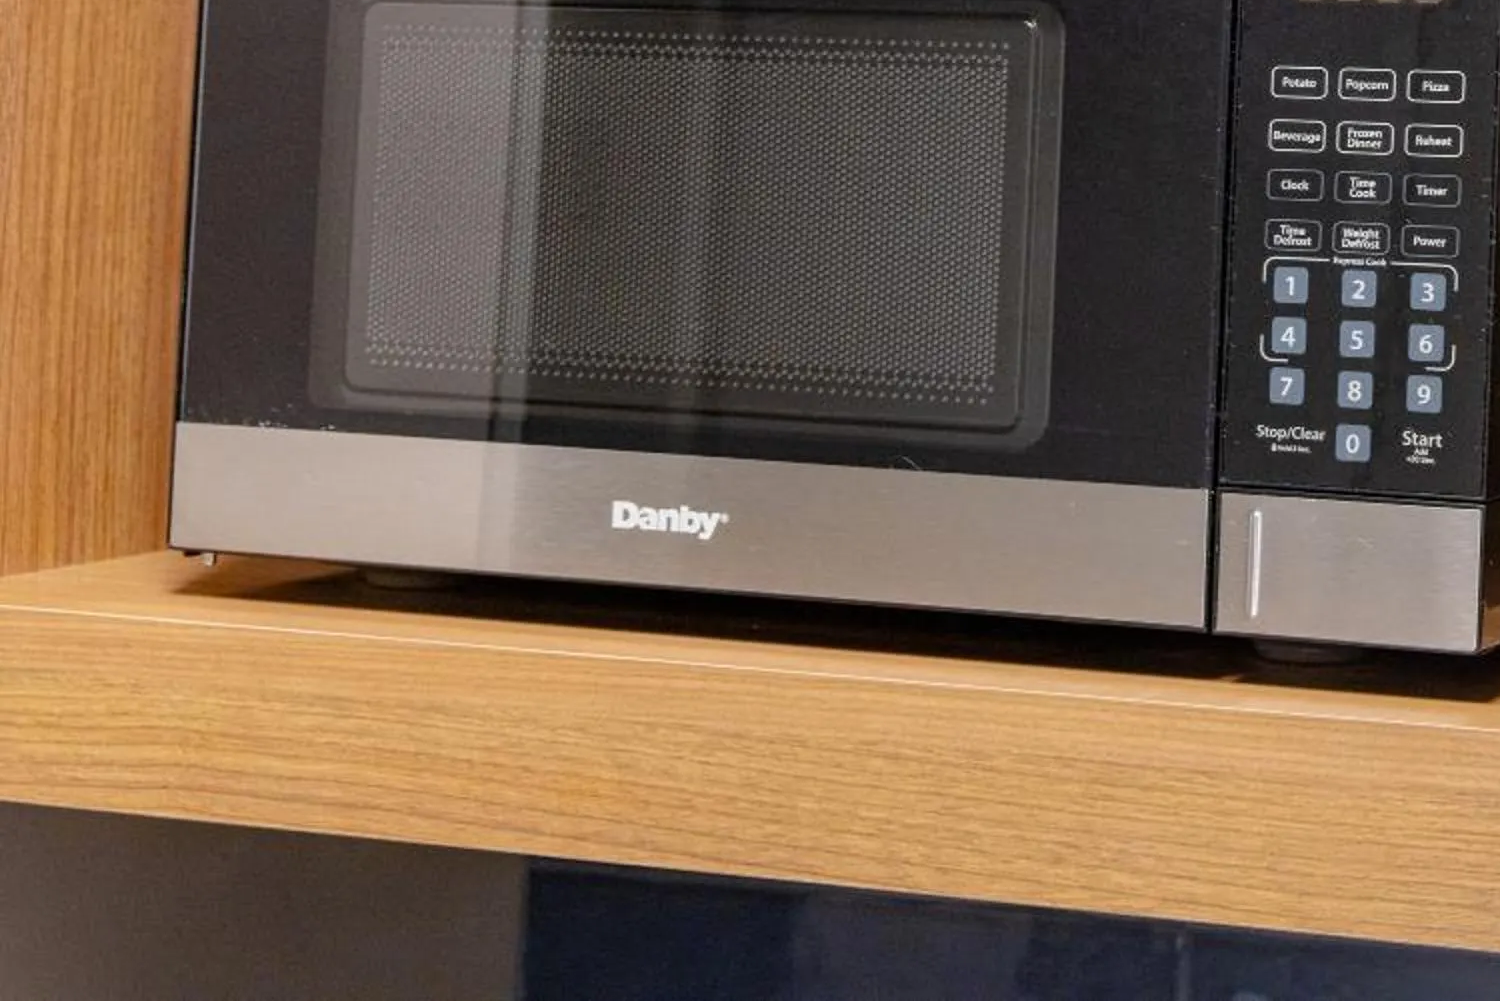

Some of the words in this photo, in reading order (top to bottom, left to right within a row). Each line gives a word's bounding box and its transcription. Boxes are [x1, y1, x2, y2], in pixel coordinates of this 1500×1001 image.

[1281, 76, 1318, 89] Potato
[1345, 79, 1390, 92] Popcorn
[1422, 80, 1451, 92] Pizza
[1273, 129, 1322, 144] Beverage
[1347, 126, 1383, 139] Frozen
[1346, 138, 1383, 149] Dinner
[1281, 179, 1310, 192] Clock
[1349, 176, 1377, 188] Time
[1348, 187, 1378, 199] Cook
[1415, 184, 1449, 196] Timer
[1279, 223, 1307, 236] Time
[1272, 234, 1313, 247] Defrost
[1341, 238, 1381, 250] Defrost
[1412, 234, 1447, 248] Power
[1284, 276, 1295, 297] 1
[1351, 280, 1366, 300] 2
[1420, 282, 1435, 303] 3
[1280, 326, 1296, 348] 4
[1350, 330, 1364, 351] 5
[1419, 333, 1433, 354] 6
[1279, 376, 1293, 397] 7
[1347, 379, 1362, 401] 8
[1416, 384, 1431, 405] 9
[1255, 424, 1327, 442] Stop/Clear
[1401, 430, 1443, 449] Start
[1345, 433, 1360, 454] 0
[611, 500, 721, 540] Danby
